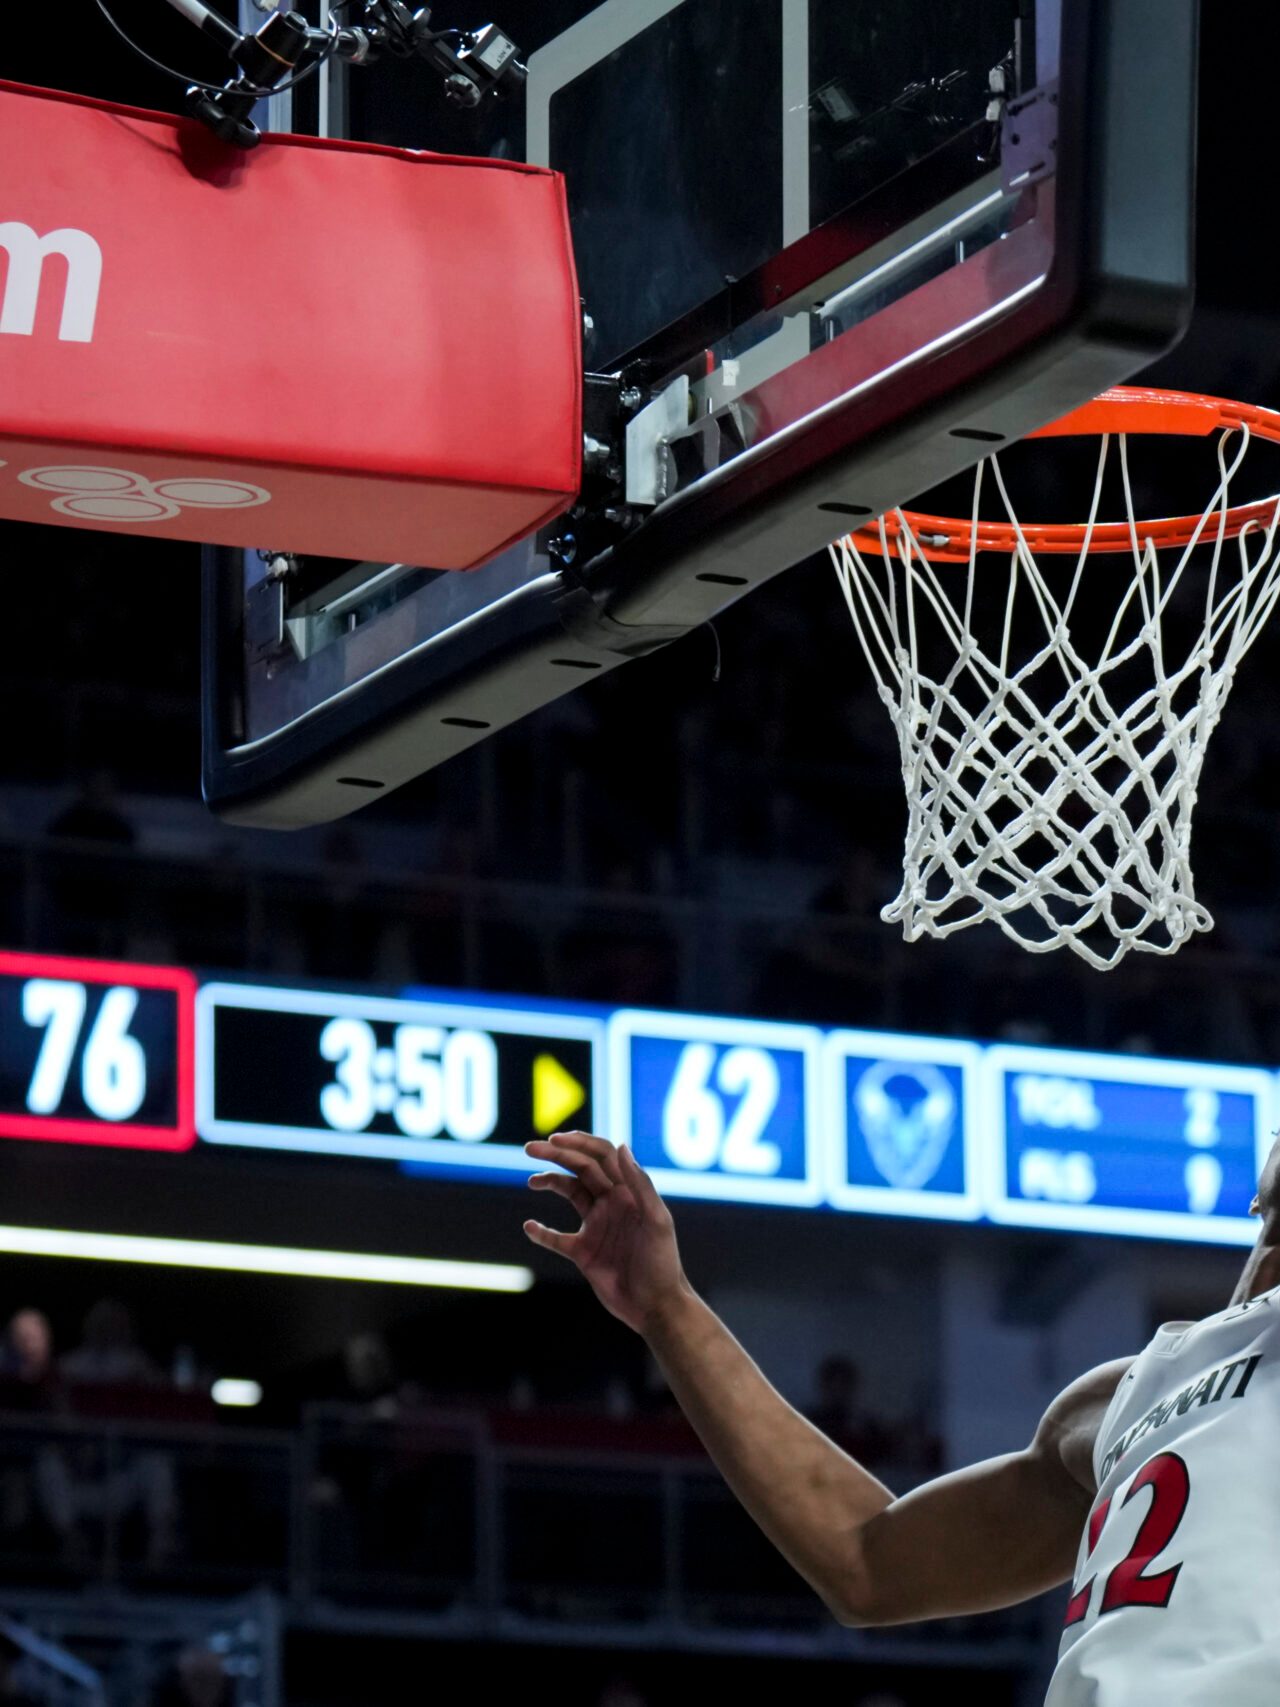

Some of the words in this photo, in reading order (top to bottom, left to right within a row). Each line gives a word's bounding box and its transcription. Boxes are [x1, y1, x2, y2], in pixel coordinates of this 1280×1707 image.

[22, 978, 147, 1122] 76
[319, 1016, 499, 1142] 3:50
[661, 1041, 782, 1175] 62
